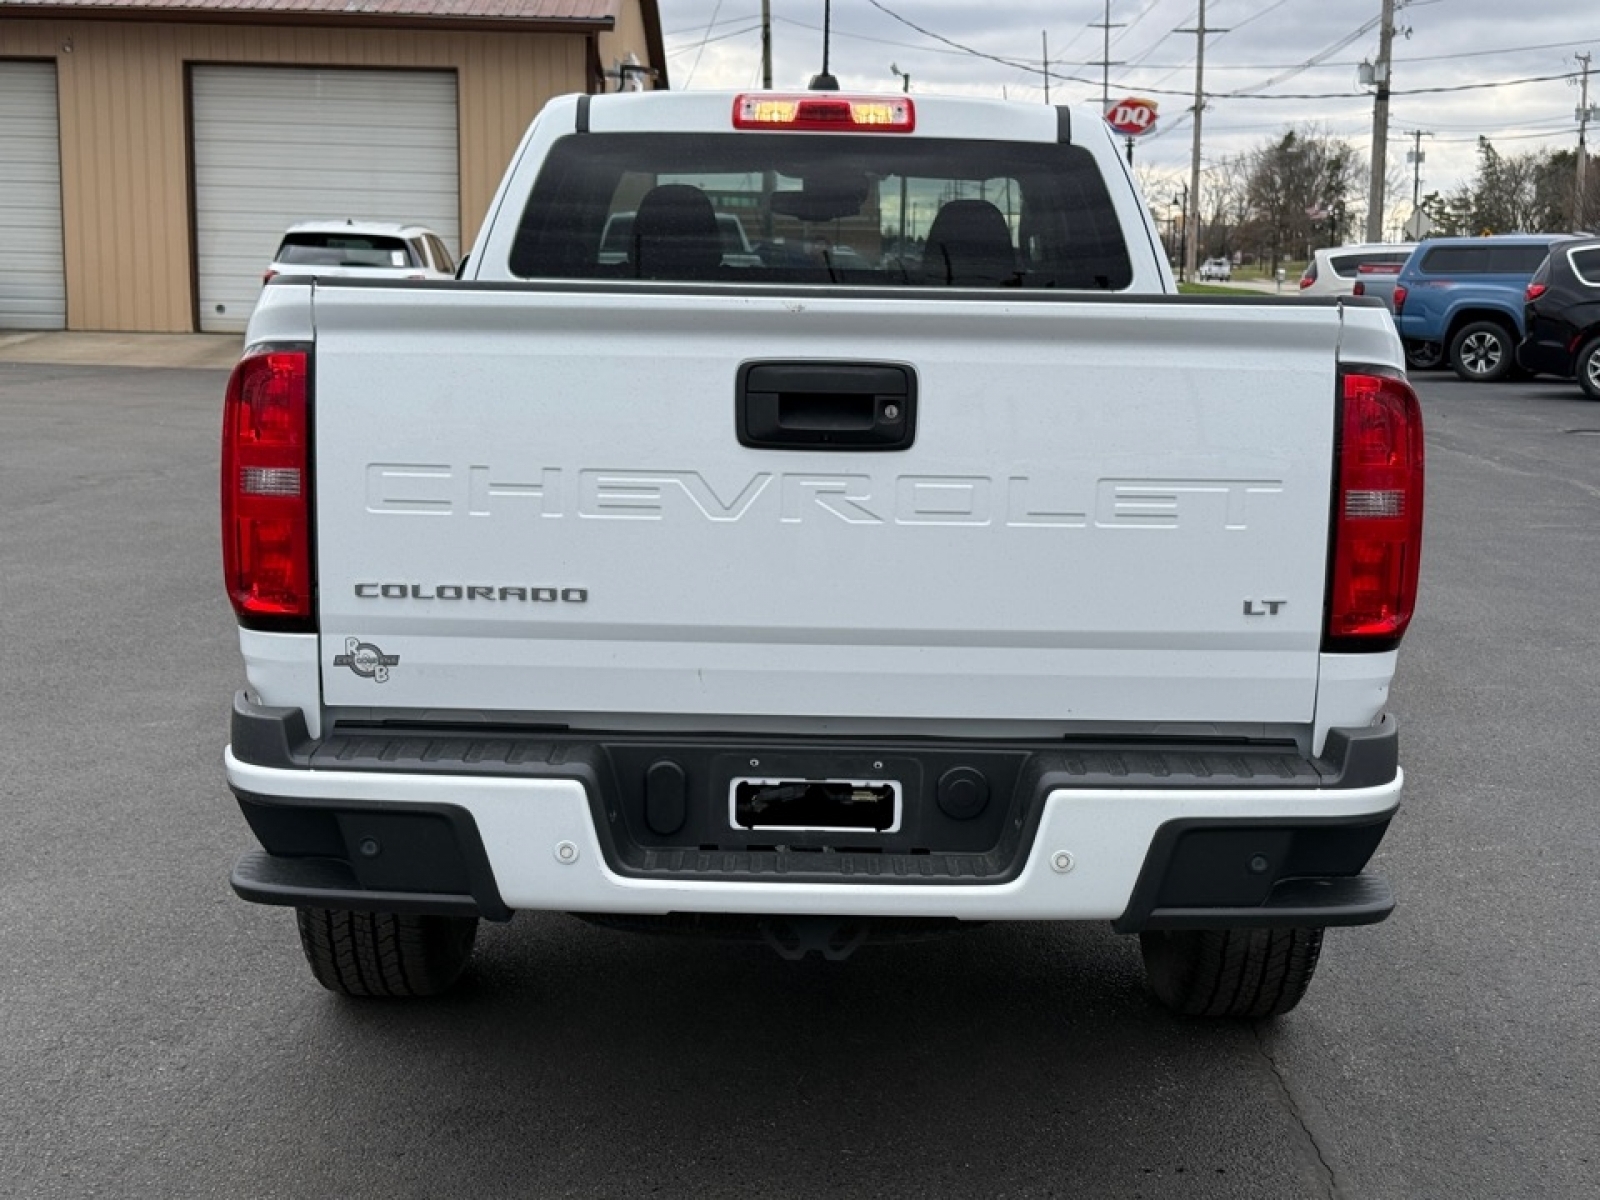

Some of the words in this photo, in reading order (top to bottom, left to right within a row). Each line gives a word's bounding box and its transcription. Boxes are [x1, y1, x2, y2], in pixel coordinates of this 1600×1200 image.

[1114, 106, 1151, 128] DQ
[365, 462, 1284, 531] CHEVROLET
[354, 582, 589, 604] COLORADO
[1243, 599, 1287, 616] LT
